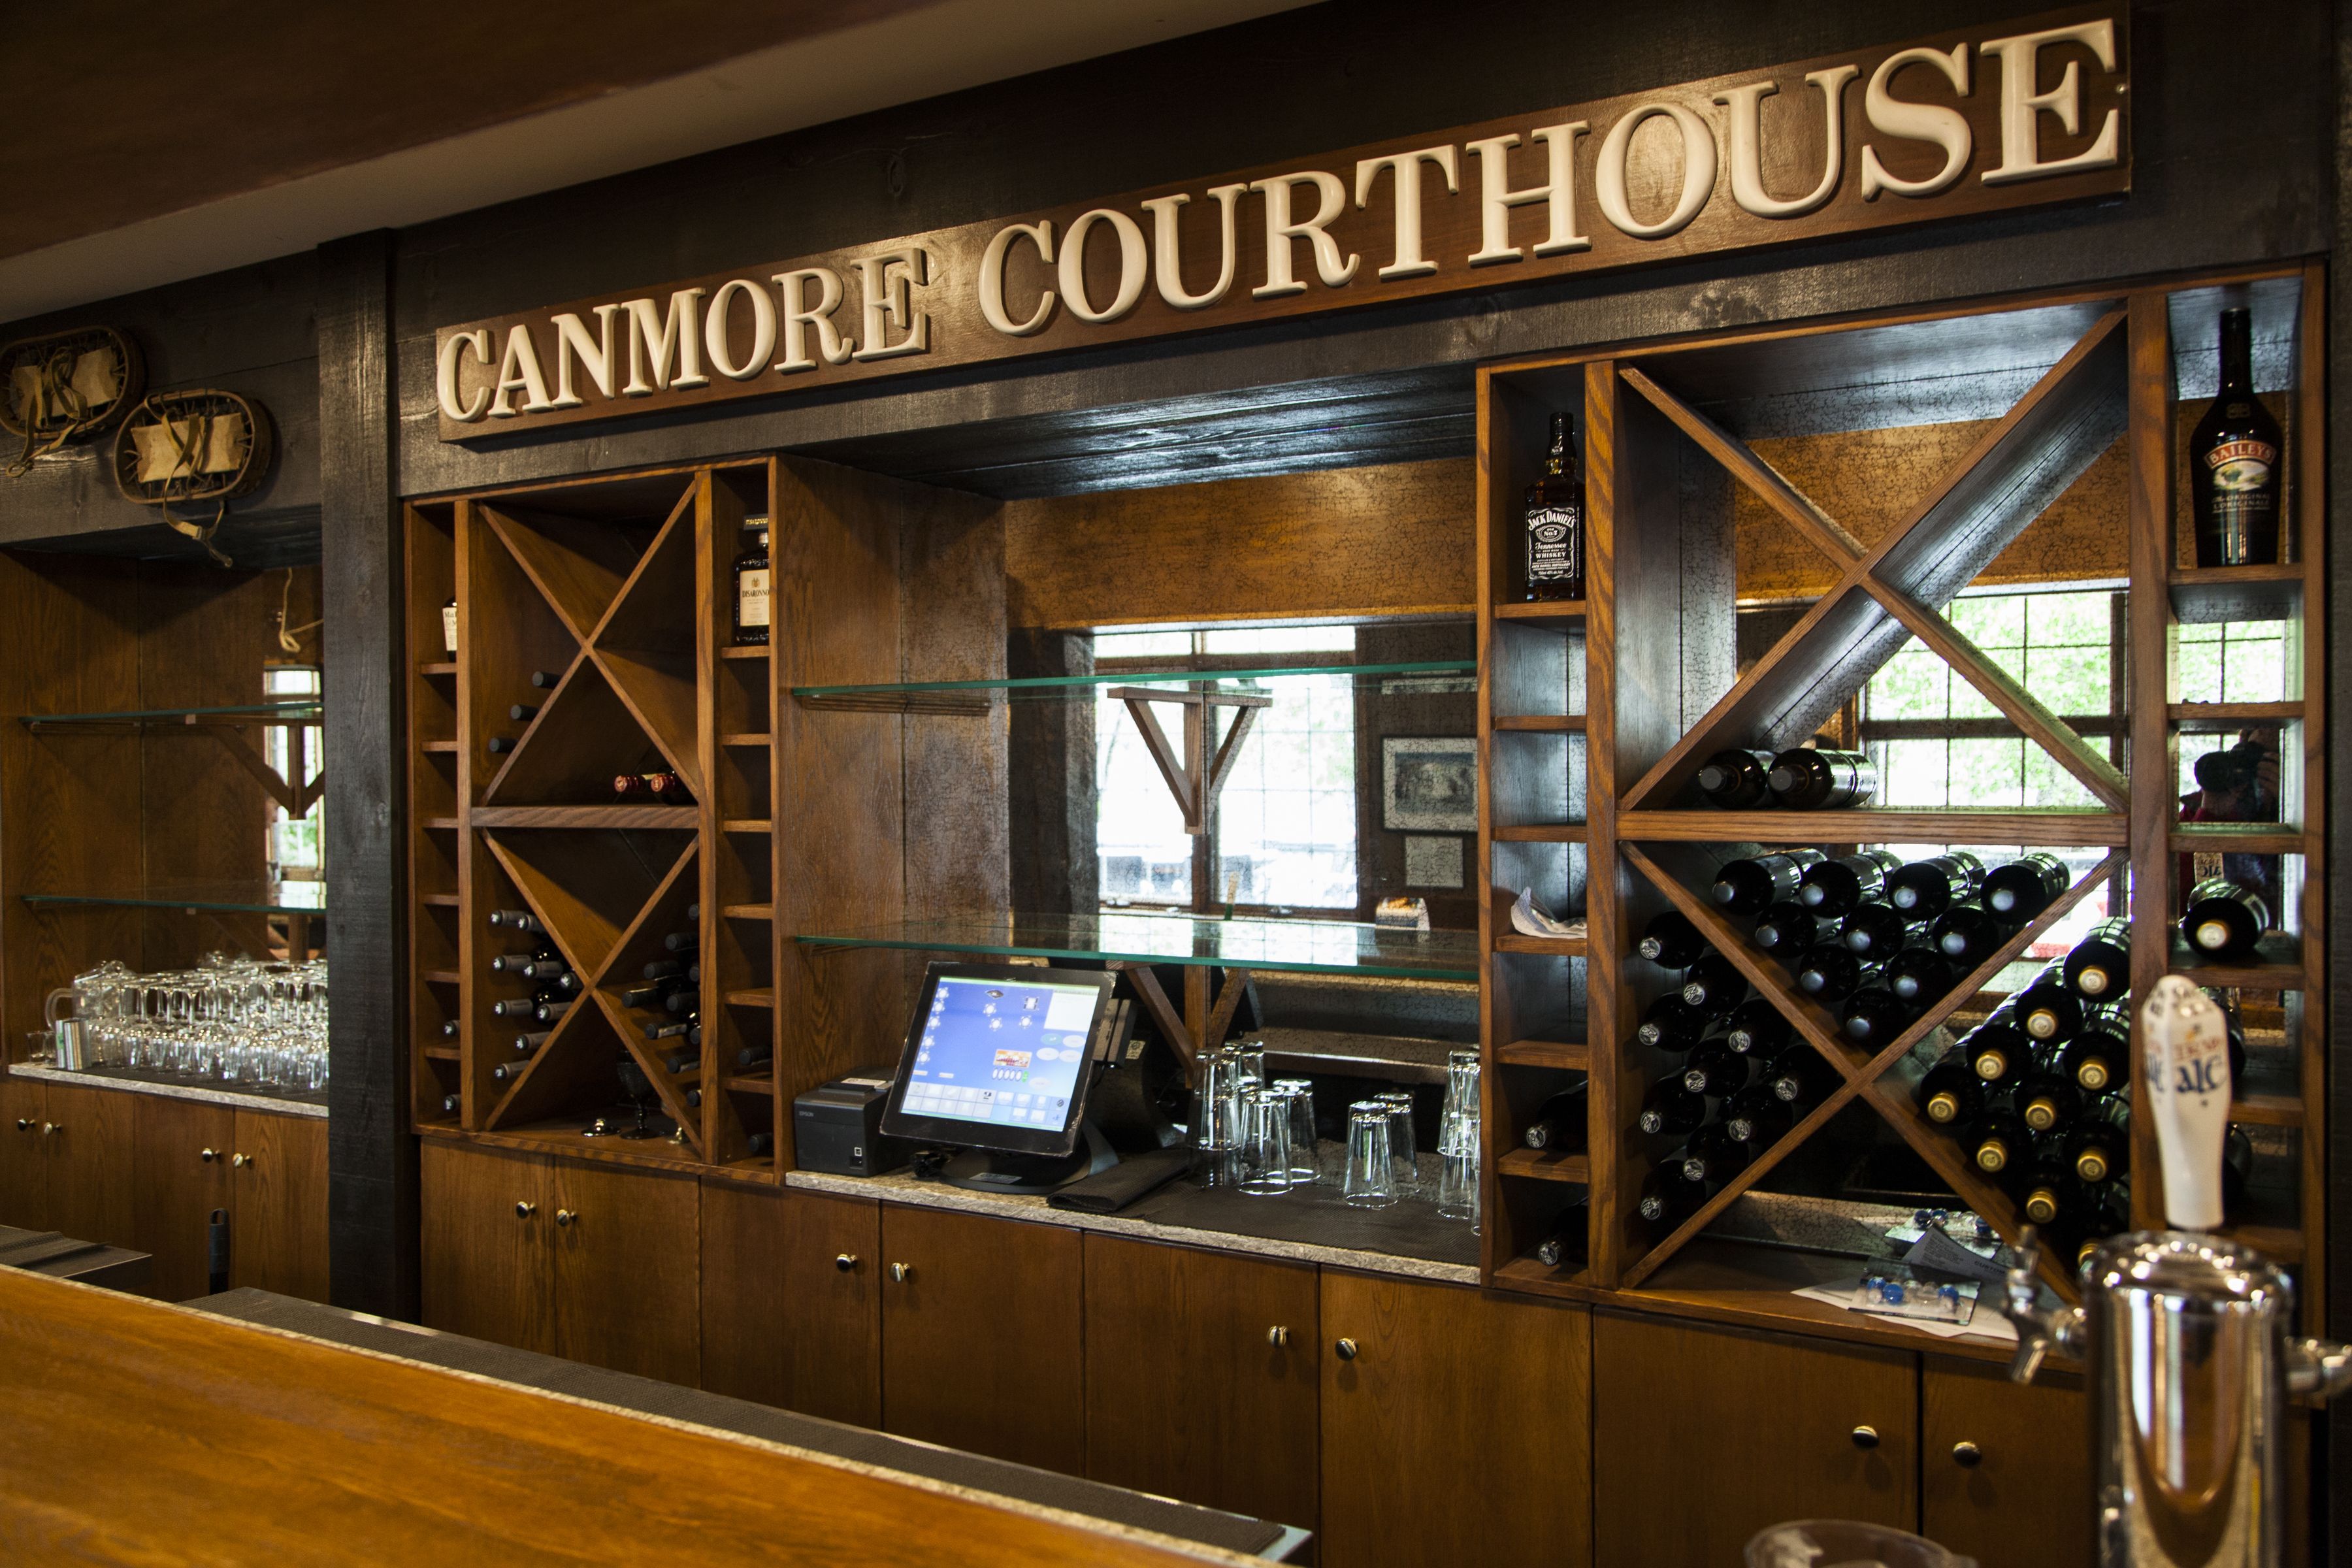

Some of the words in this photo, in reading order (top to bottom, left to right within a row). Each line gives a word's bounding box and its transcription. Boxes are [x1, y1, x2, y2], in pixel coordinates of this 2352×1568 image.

[436, 248, 926, 422] CANMORE
[978, 18, 2118, 336] COURTHOUSE
[2209, 444, 2270, 463] BAILEYS
[1528, 514, 1546, 530] JACK
[1546, 511, 1576, 527] DANIEL'S
